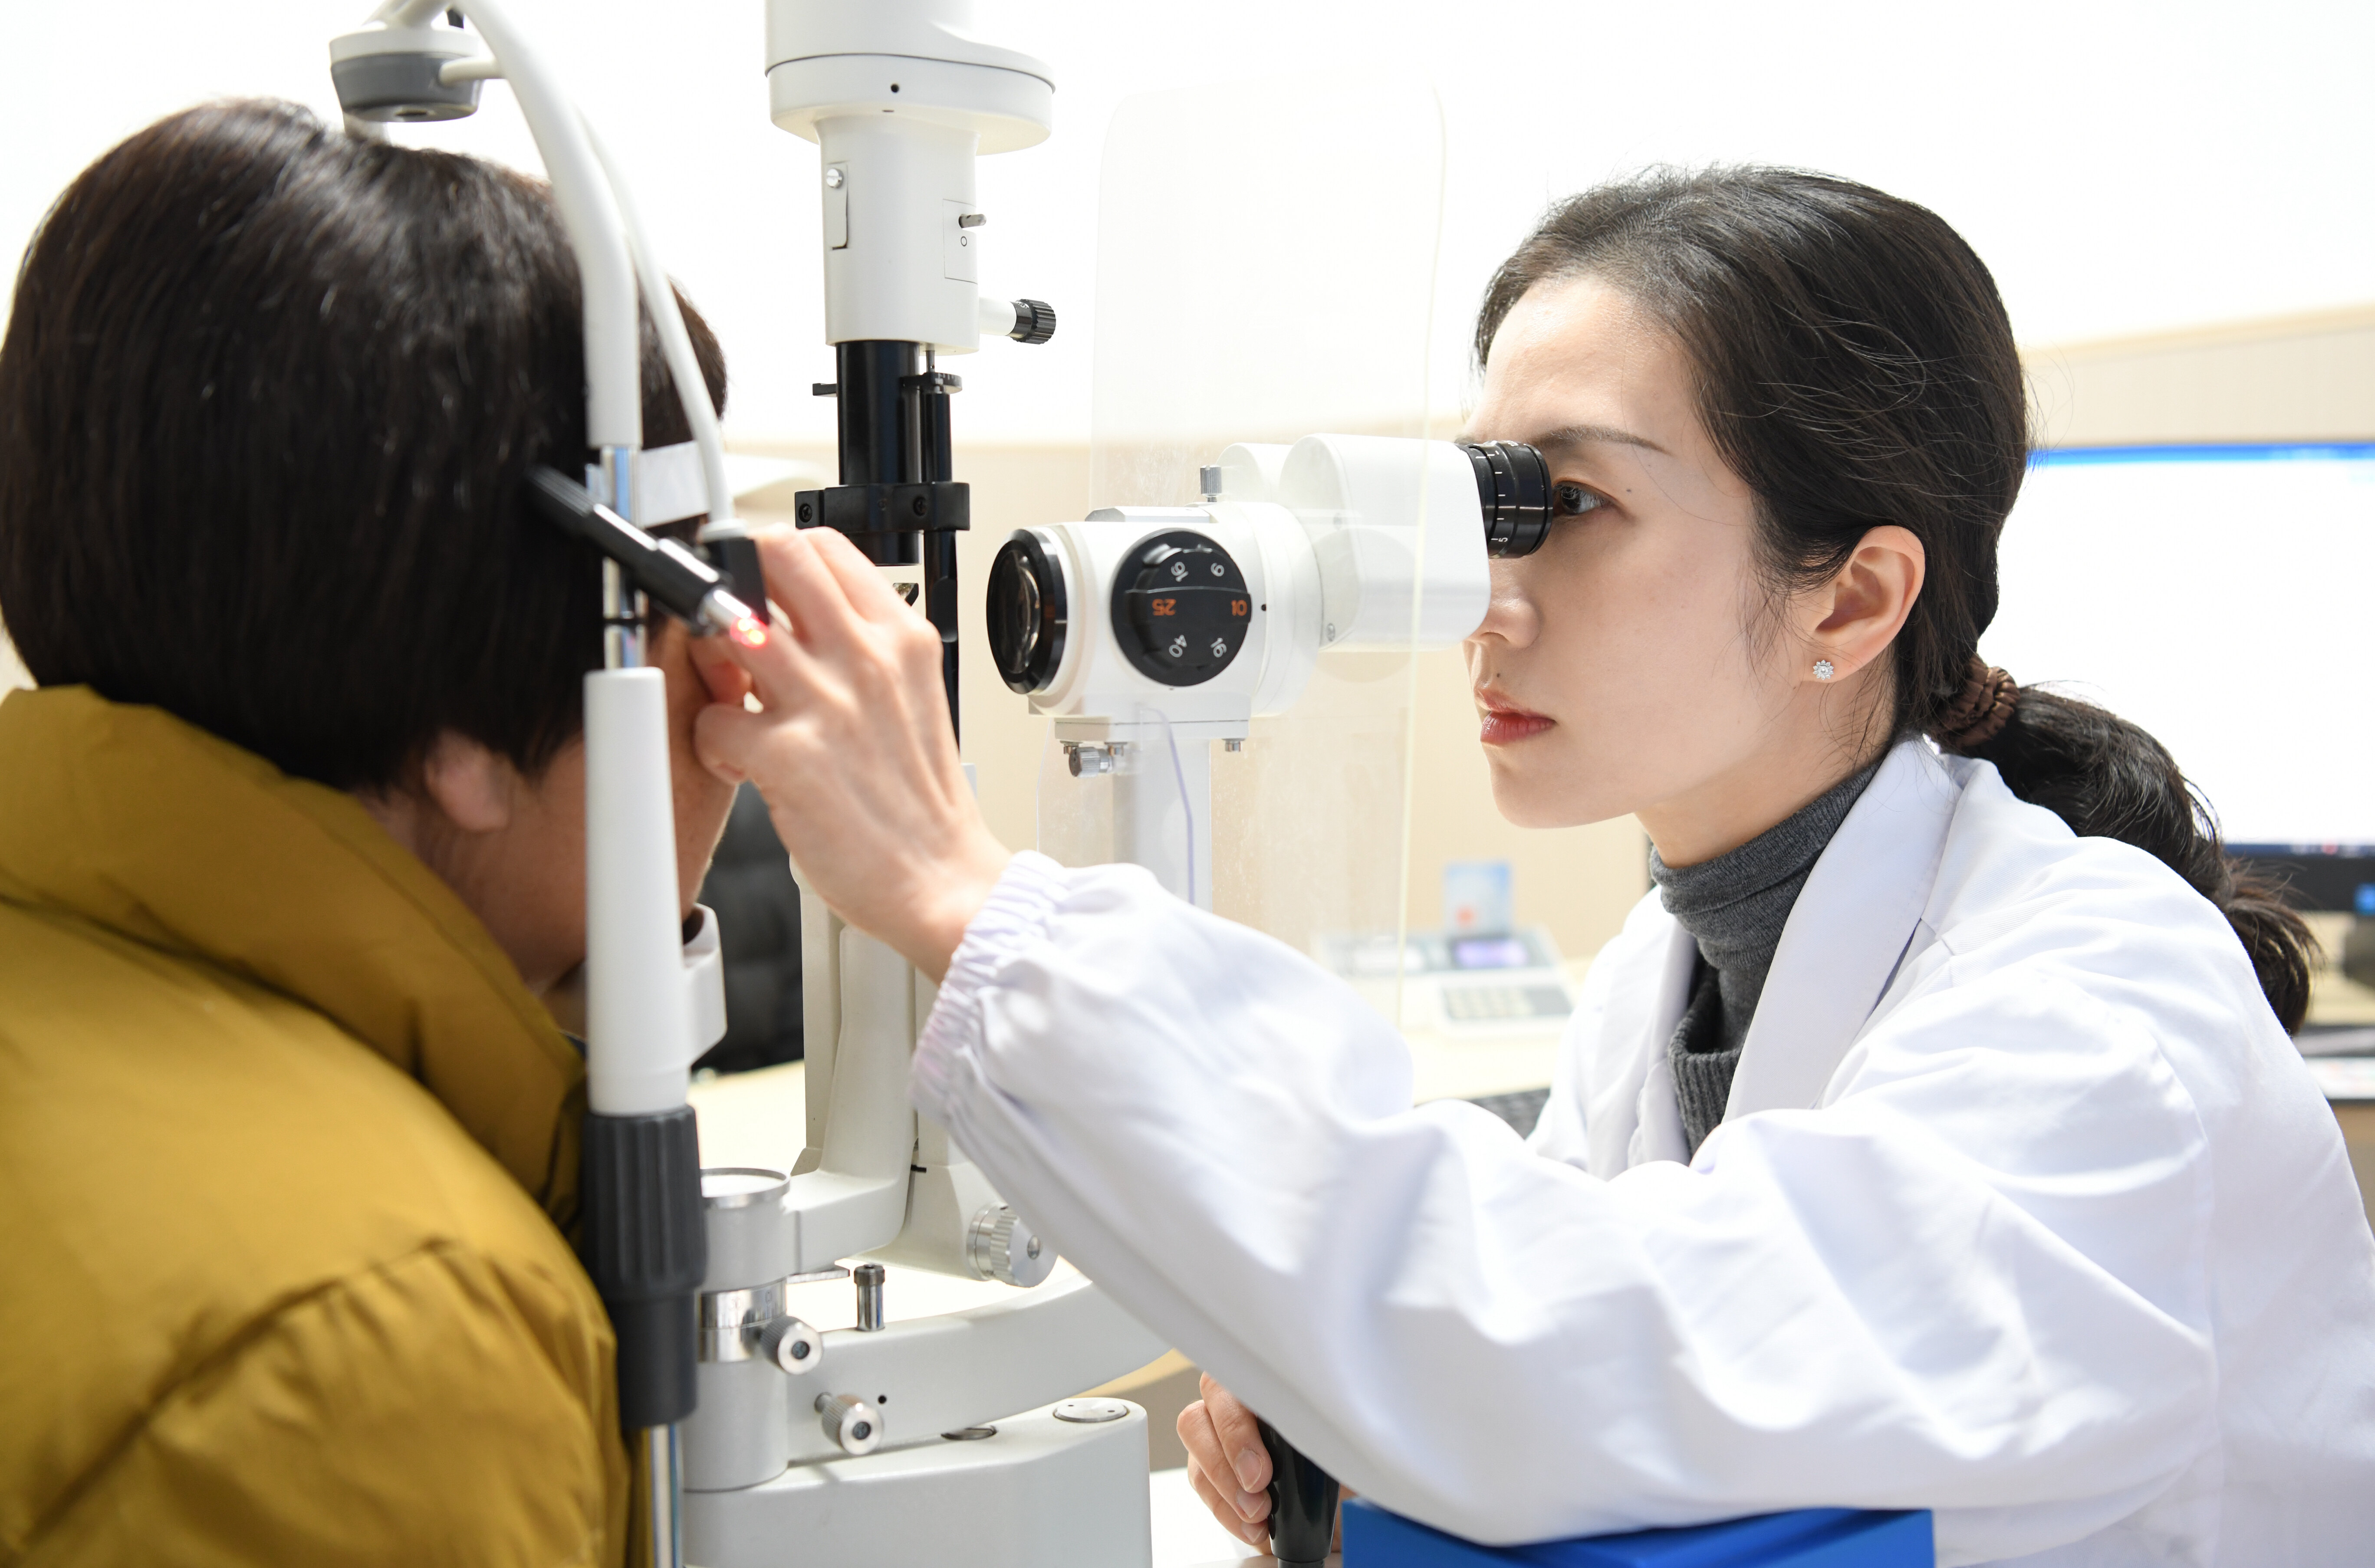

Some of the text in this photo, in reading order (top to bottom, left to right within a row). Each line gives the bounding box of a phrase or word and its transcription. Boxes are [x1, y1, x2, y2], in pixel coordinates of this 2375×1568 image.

[1171, 561, 1189, 582] 16
[1151, 598, 1177, 616] 25
[1230, 599, 1248, 616] 10
[1168, 634, 1187, 658] 40
[1210, 638, 1227, 658] 16
